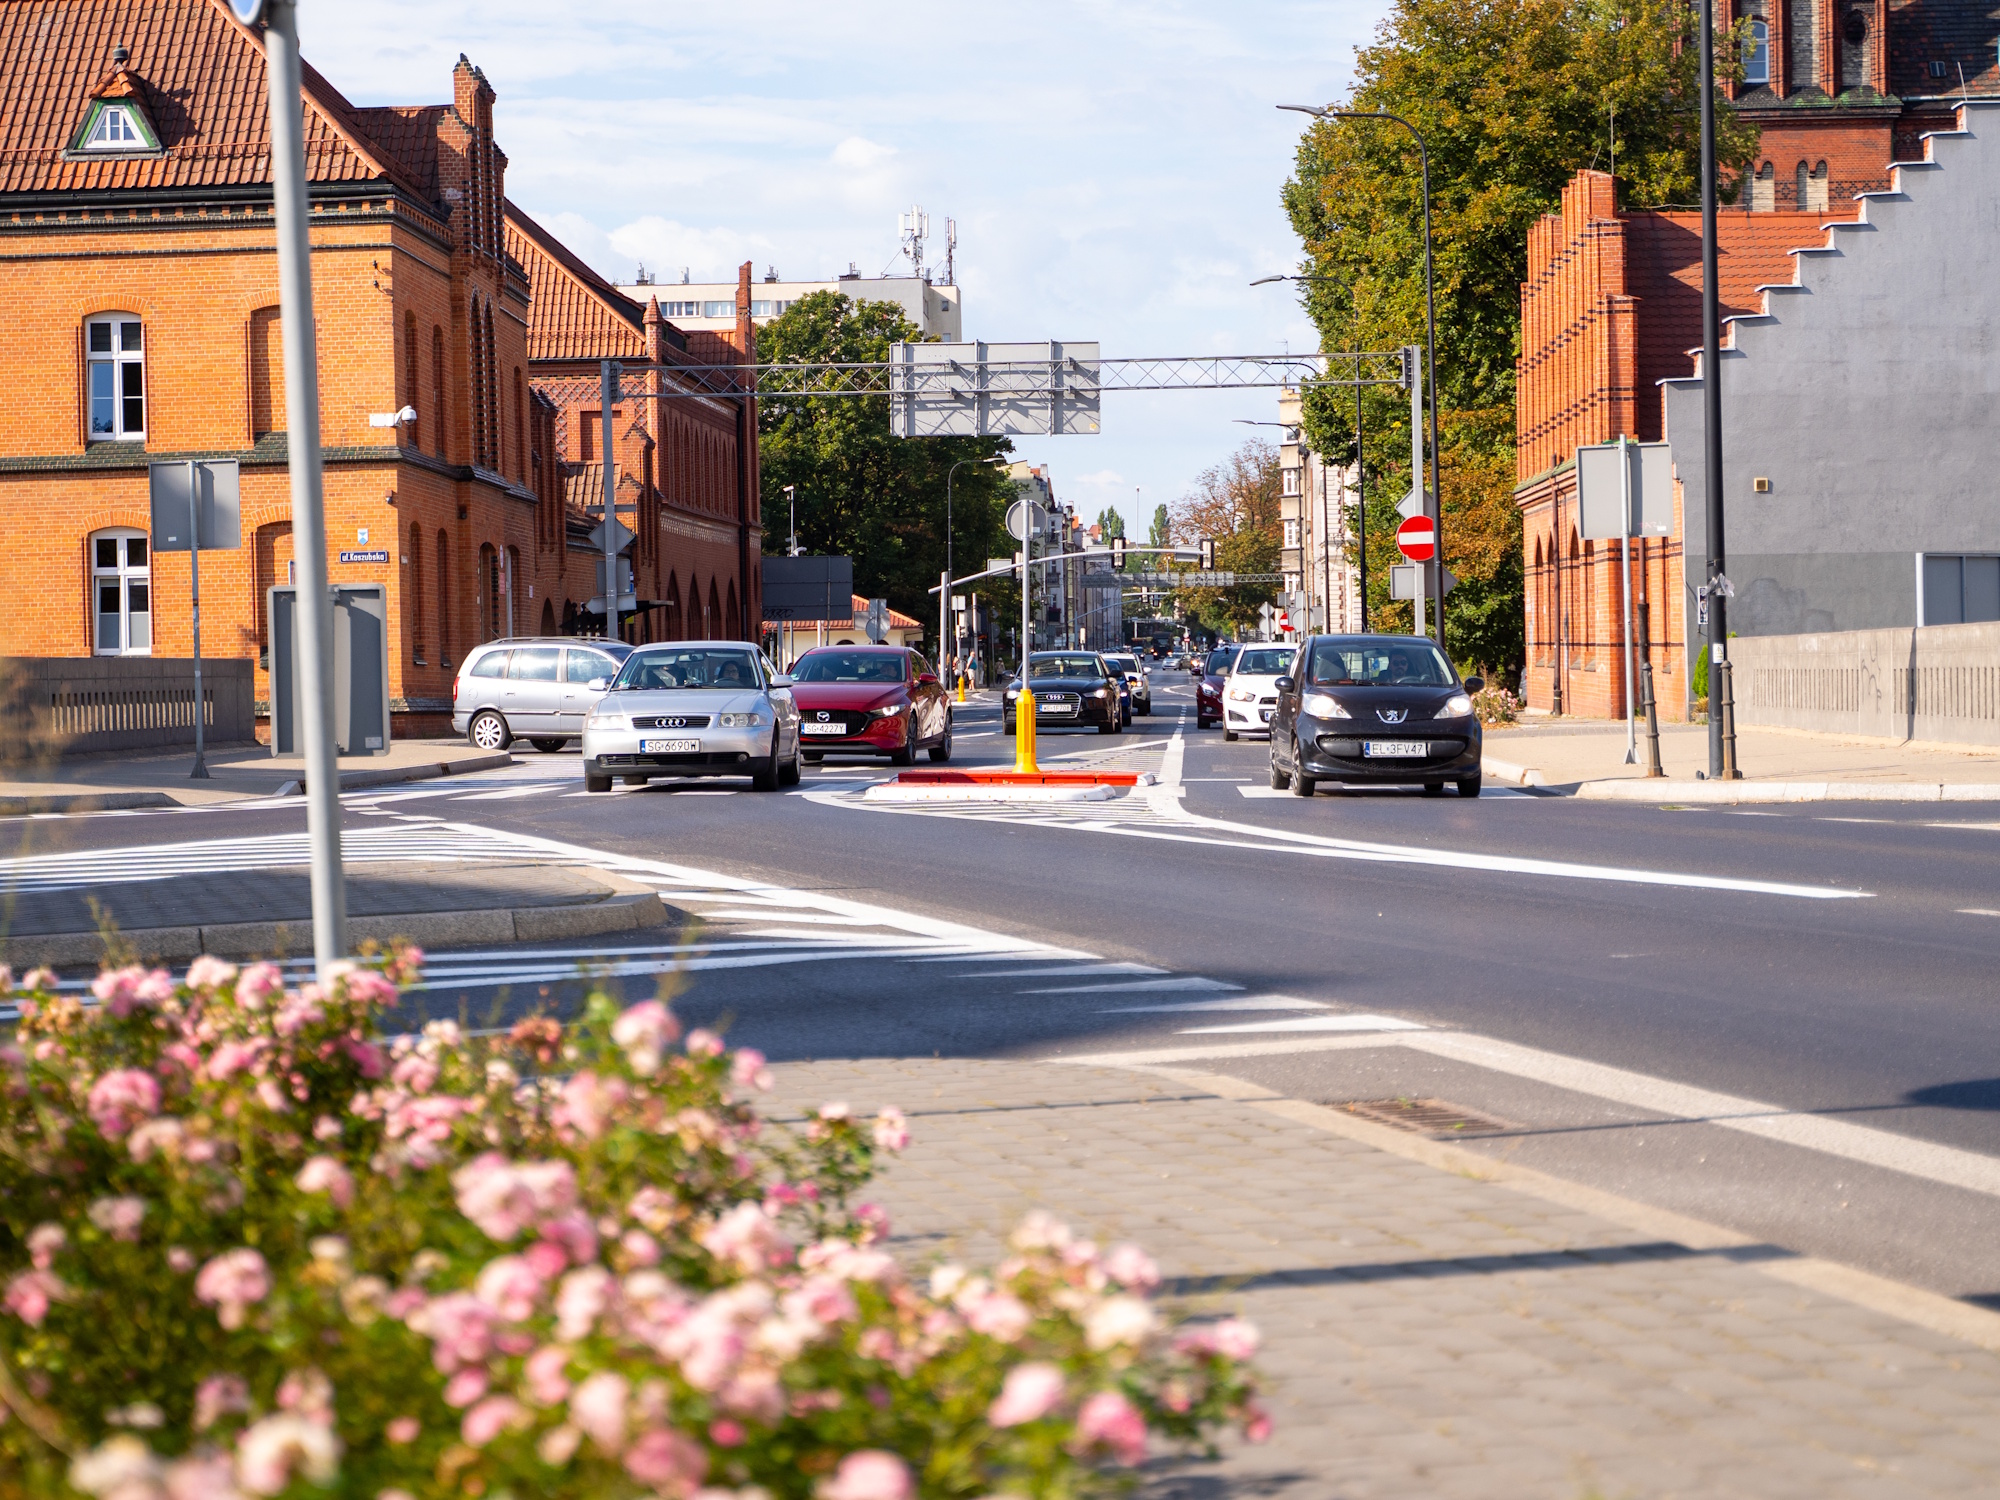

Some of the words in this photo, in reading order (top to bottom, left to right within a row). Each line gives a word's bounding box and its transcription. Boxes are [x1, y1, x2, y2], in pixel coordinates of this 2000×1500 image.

[350, 552, 385, 561] Kaszubska
[806, 724, 817, 733] SG
[819, 724, 844, 733] 4227Y
[647, 741, 661, 752] SG
[664, 740, 697, 751] 6690W
[1372, 743, 1386, 754] EL
[1390, 743, 1423, 755] 3FV47
